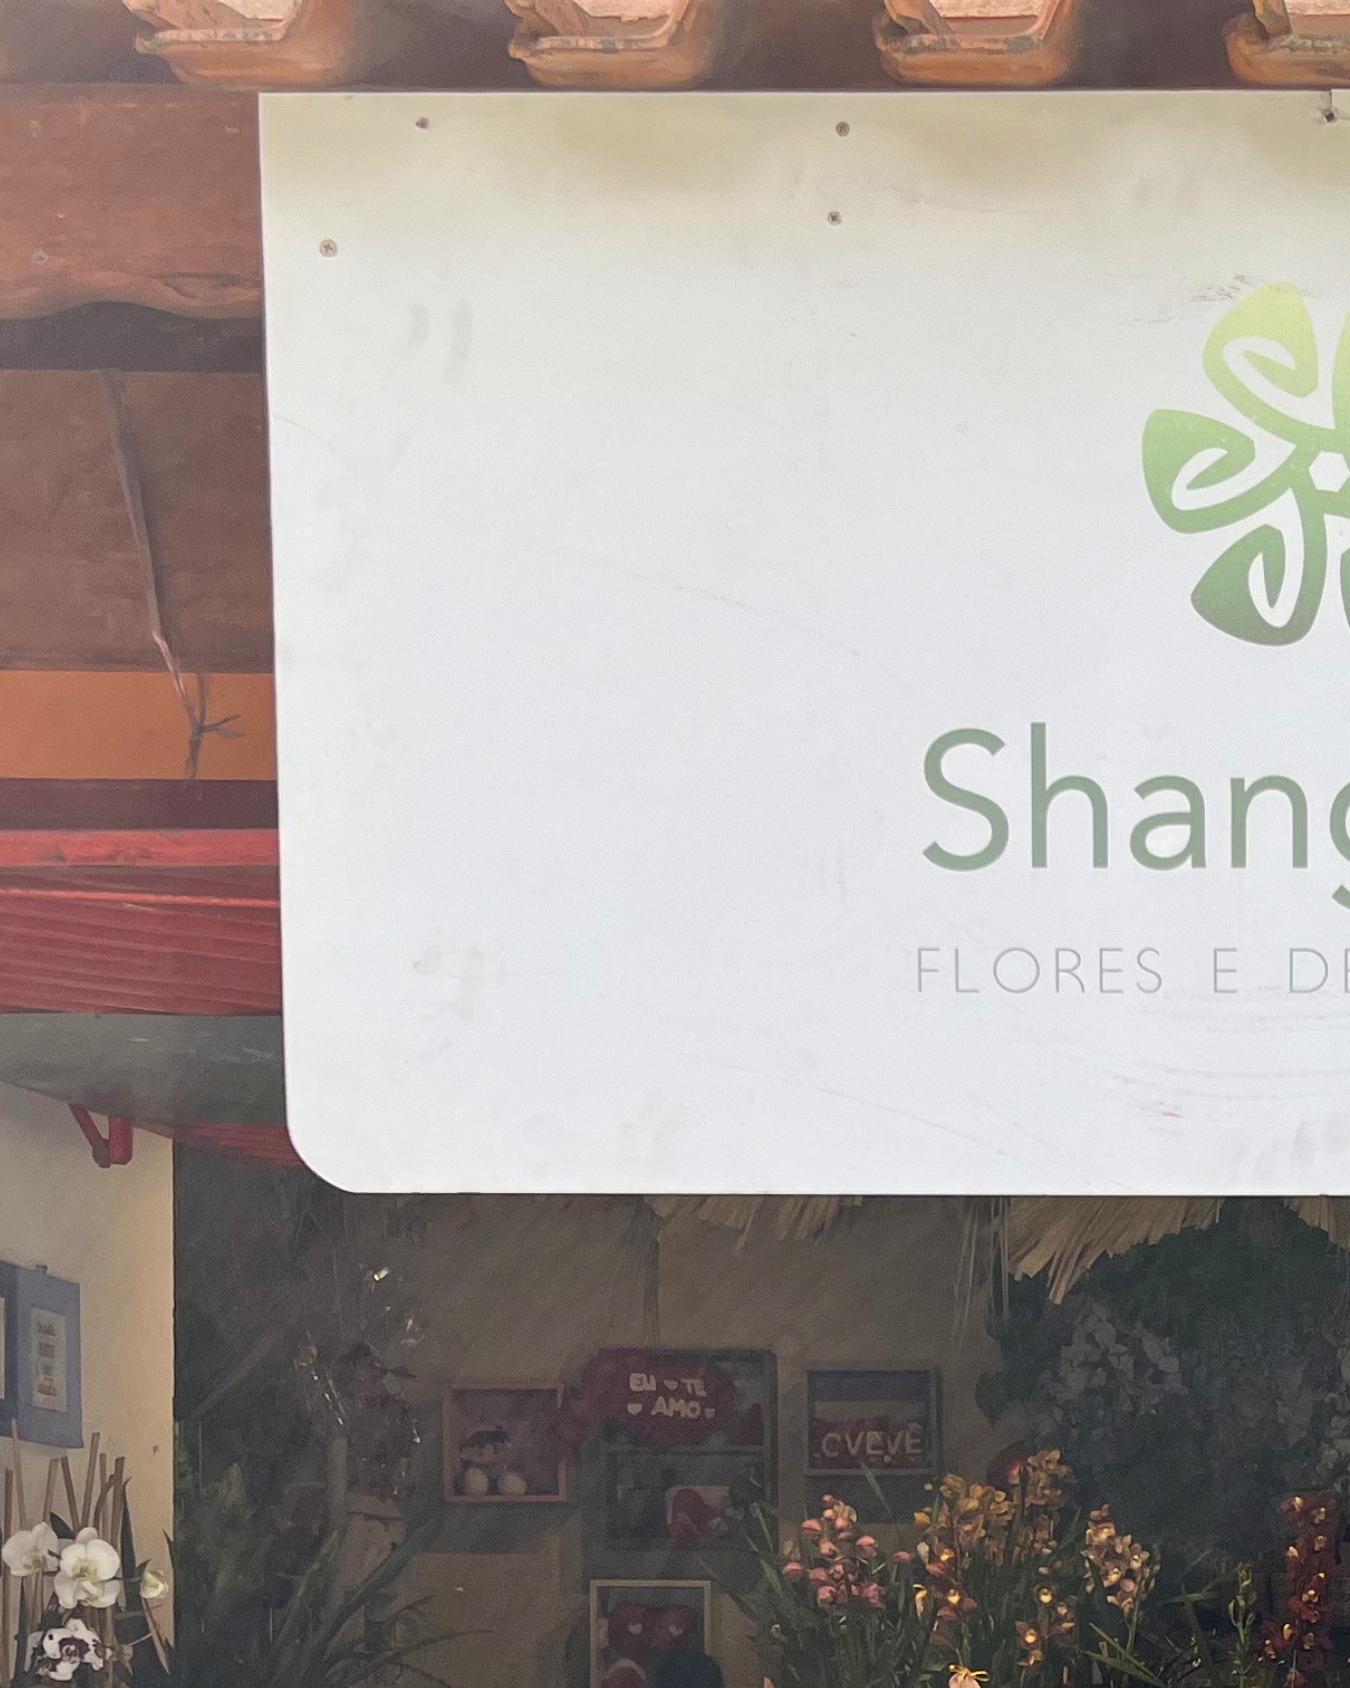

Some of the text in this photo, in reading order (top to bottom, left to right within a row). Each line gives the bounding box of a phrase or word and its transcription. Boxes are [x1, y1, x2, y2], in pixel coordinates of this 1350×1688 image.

[917, 946, 1164, 995] FLORES
[1212, 947, 1239, 995] E
[629, 1372, 708, 1397] EU TE
[650, 1395, 702, 1419] AMO
